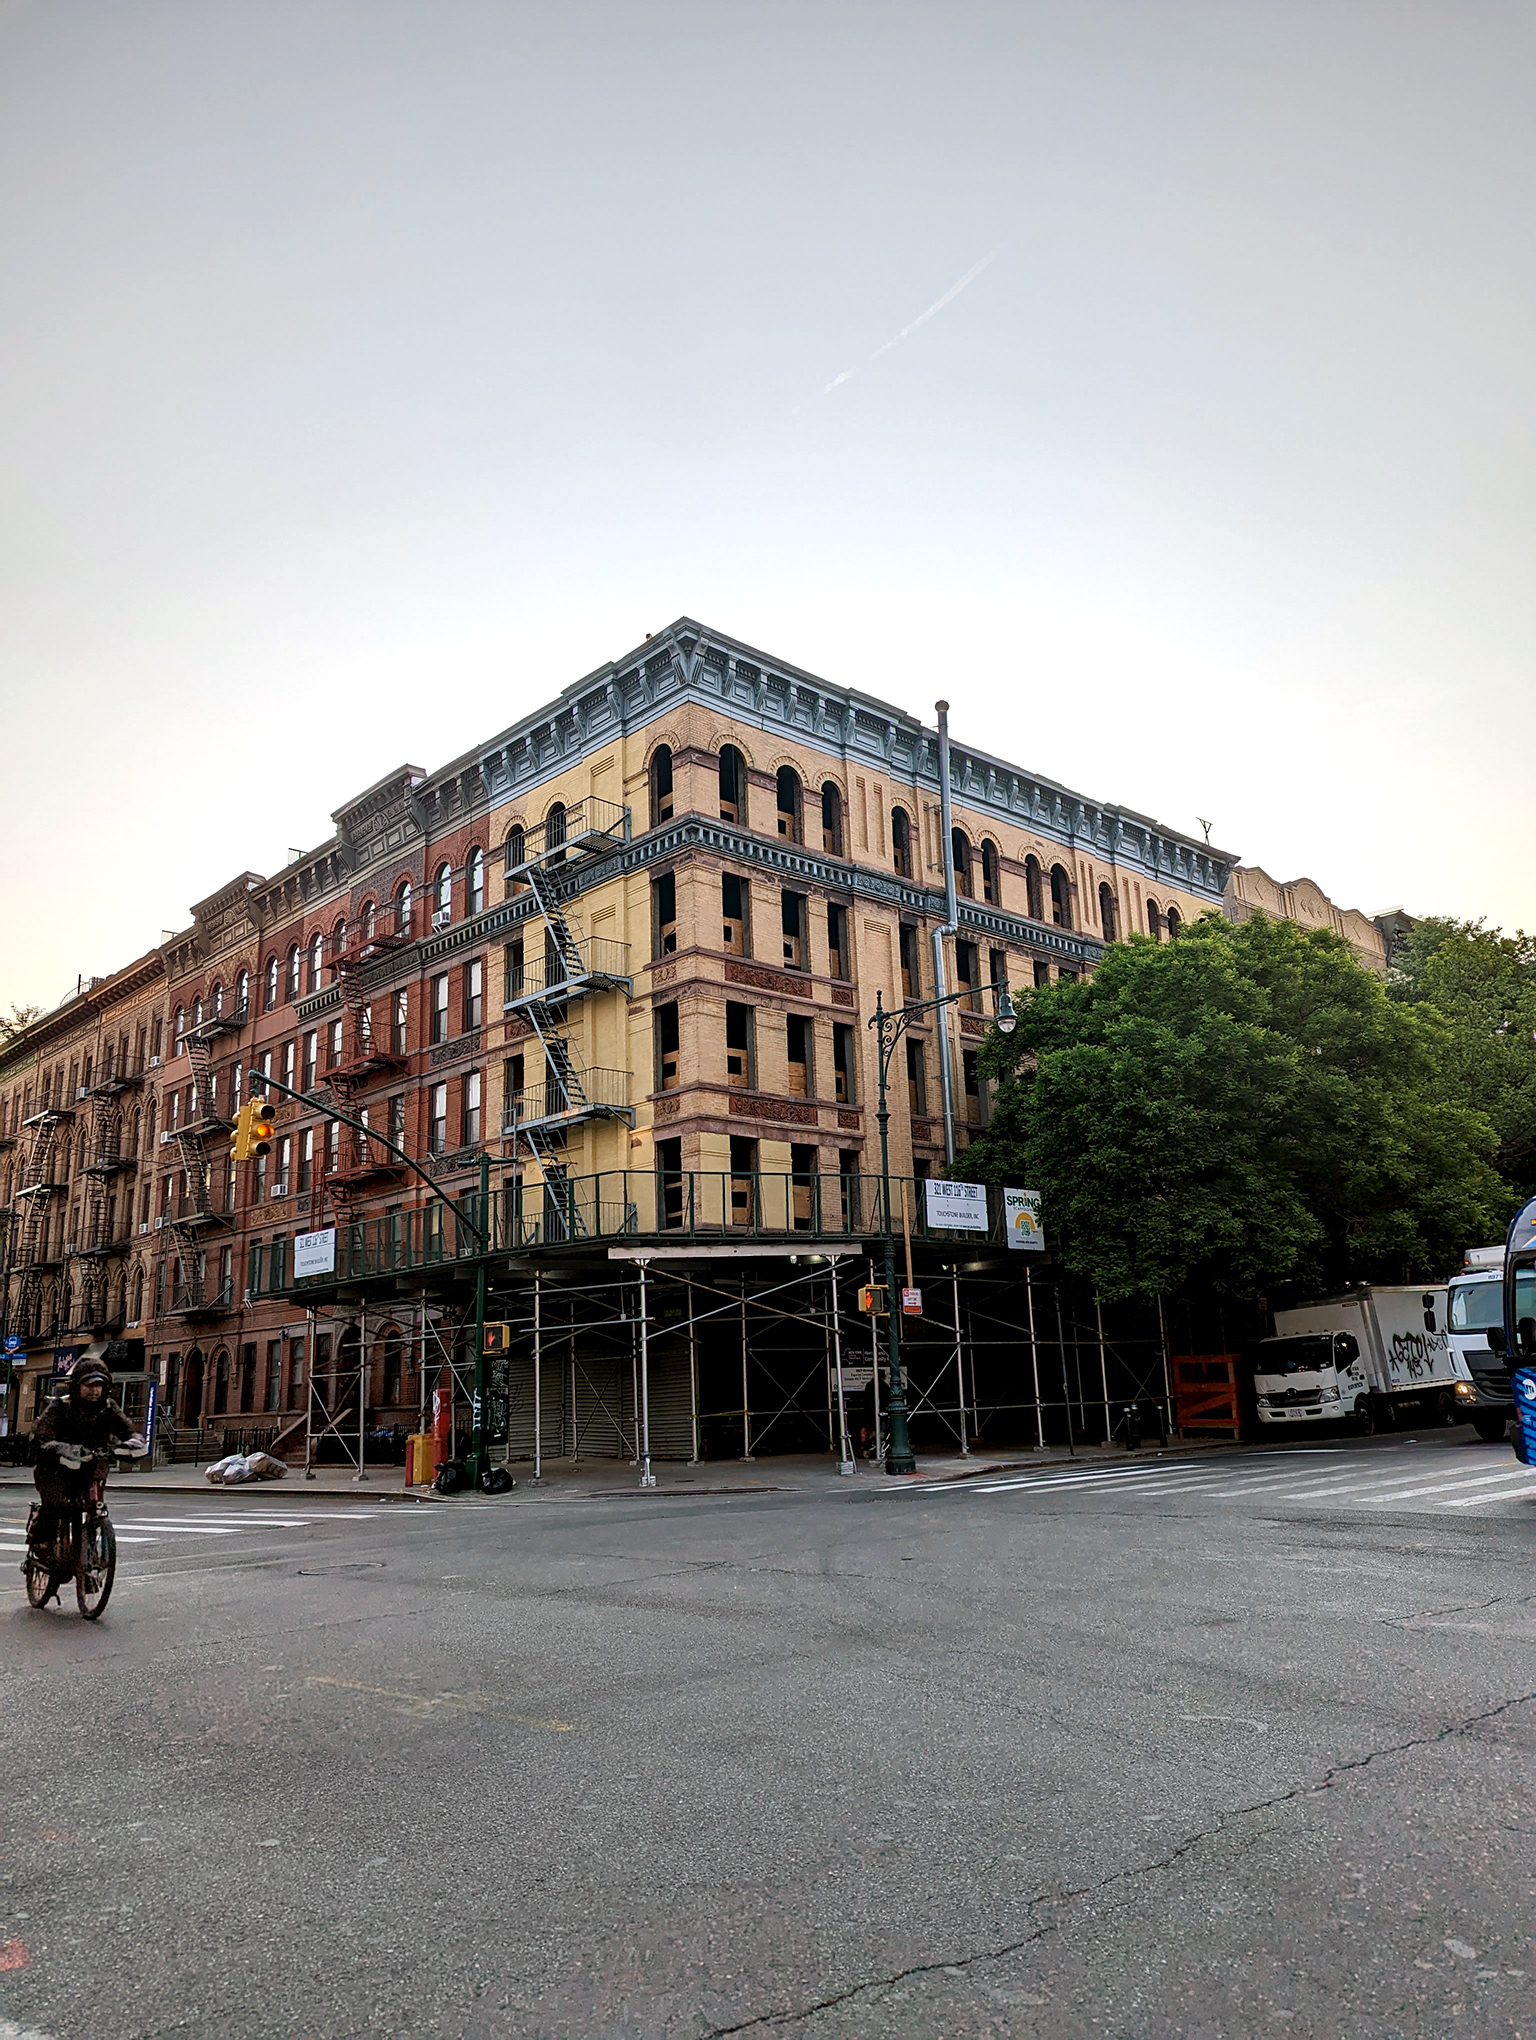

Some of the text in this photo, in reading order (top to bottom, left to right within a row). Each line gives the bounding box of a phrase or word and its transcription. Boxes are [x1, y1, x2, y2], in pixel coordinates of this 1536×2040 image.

[933, 1182, 942, 1195] 321
[942, 1183, 953, 1196] WEST
[964, 1185, 978, 1198] STREET
